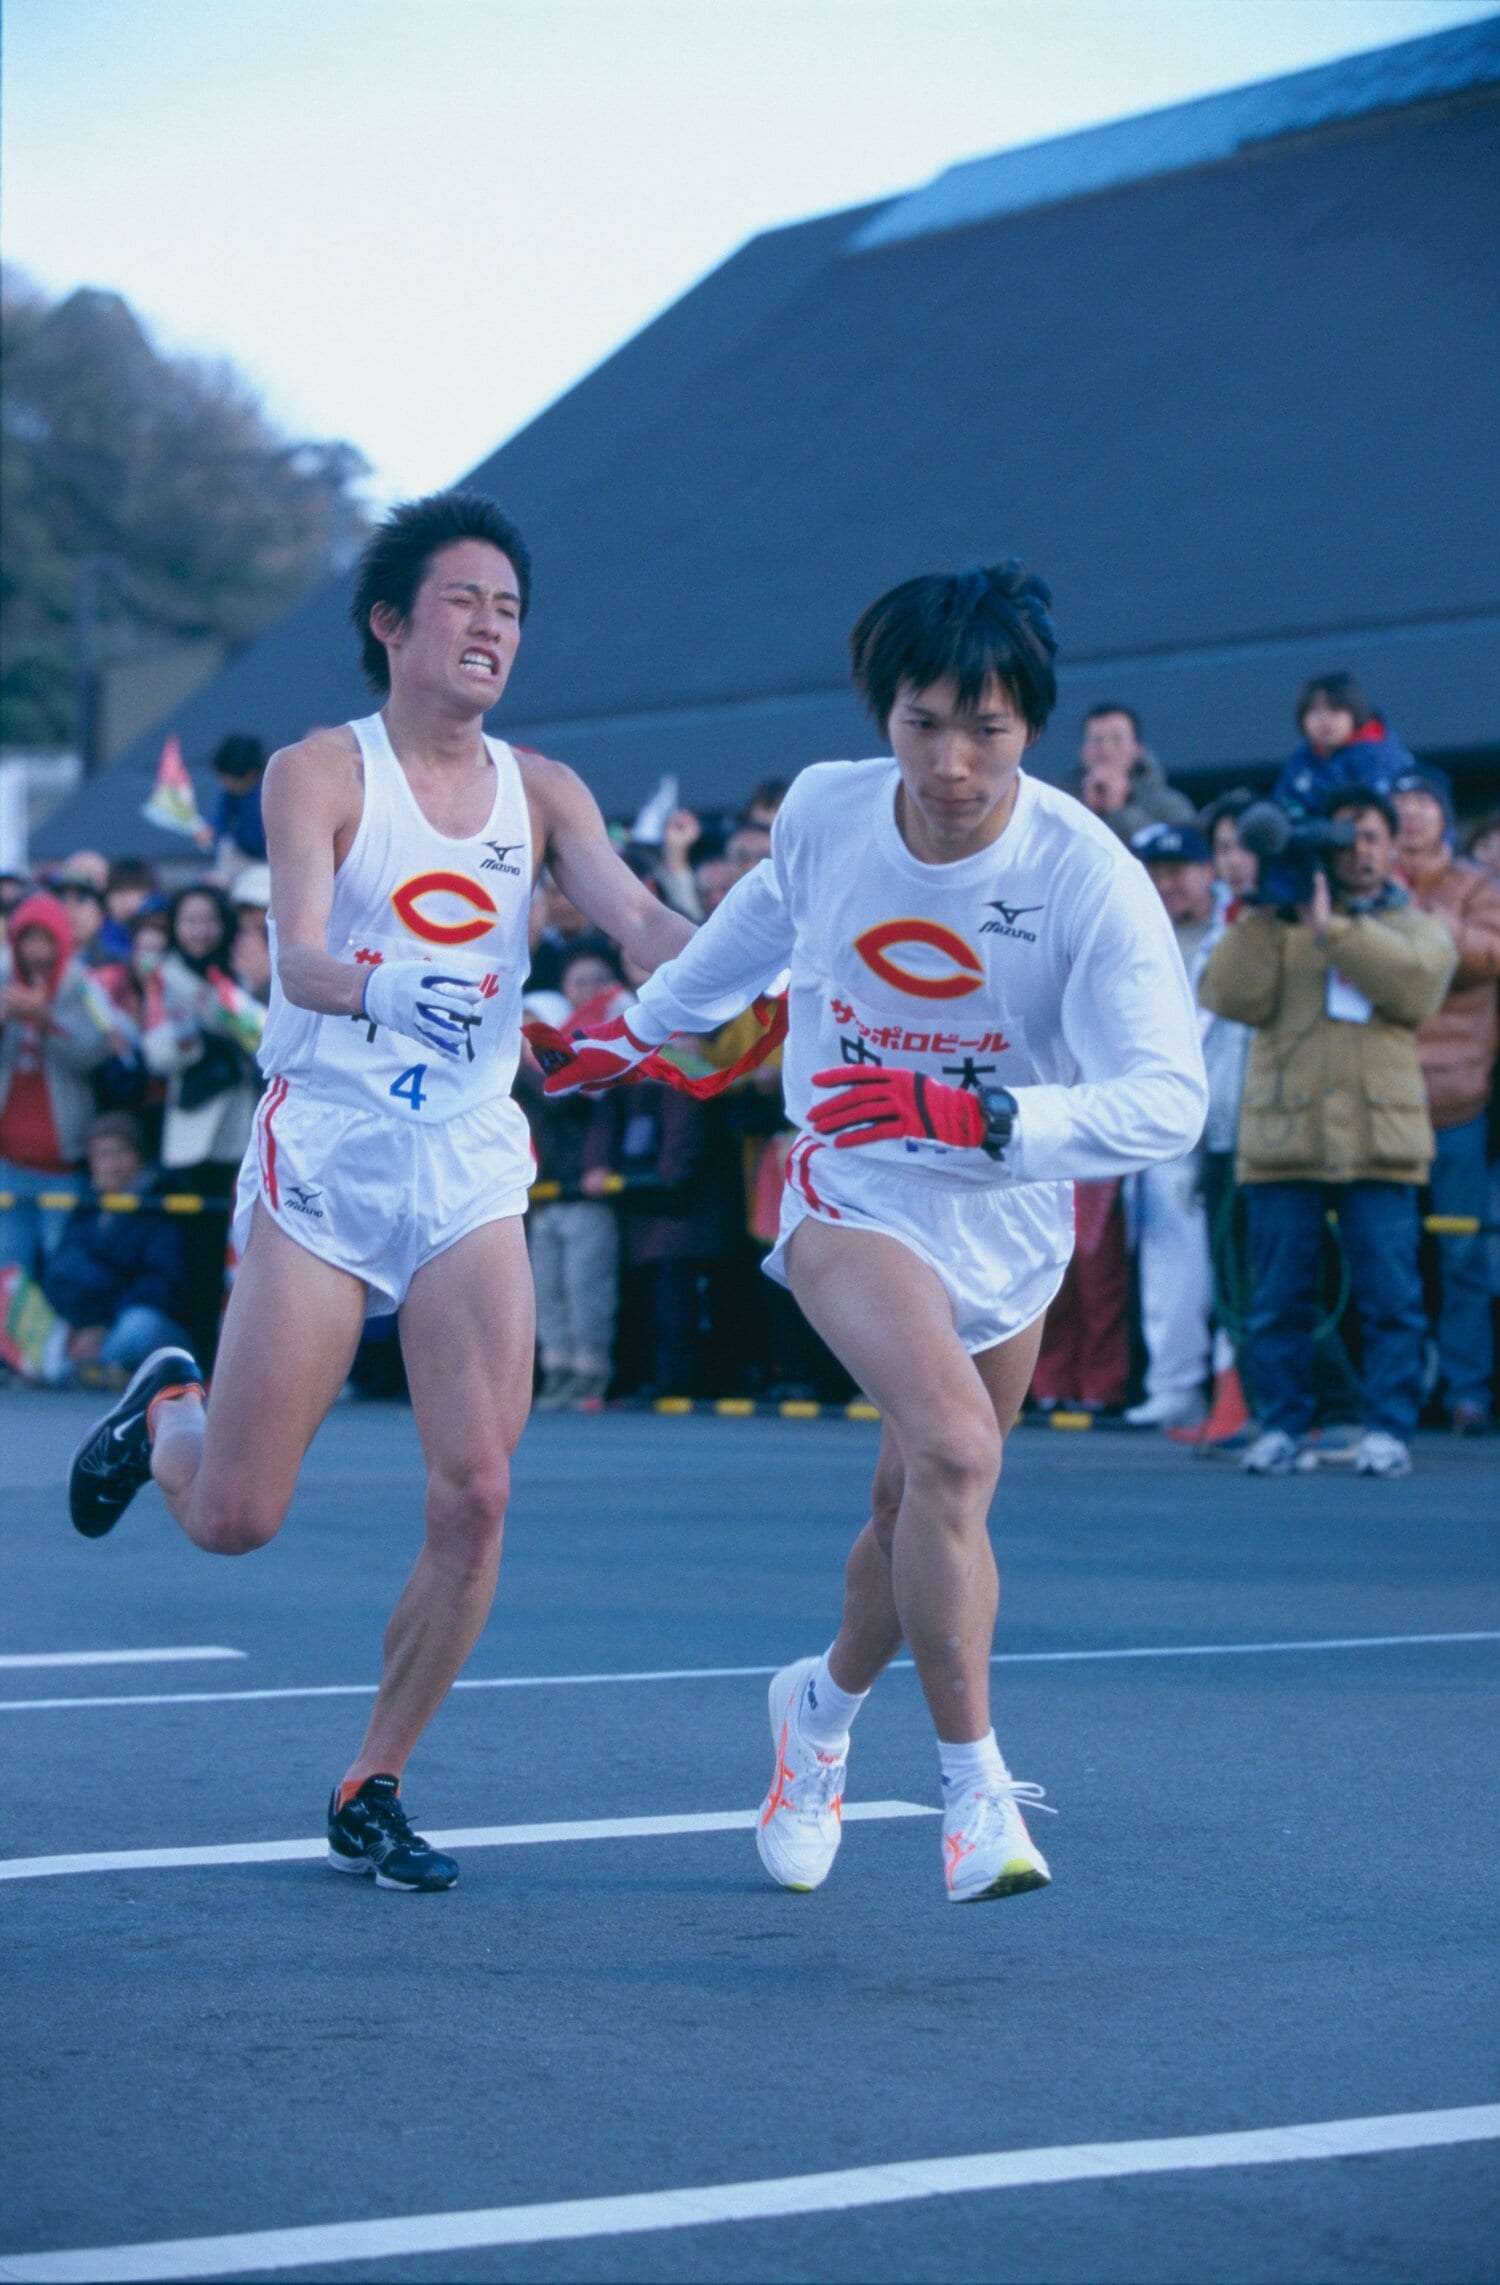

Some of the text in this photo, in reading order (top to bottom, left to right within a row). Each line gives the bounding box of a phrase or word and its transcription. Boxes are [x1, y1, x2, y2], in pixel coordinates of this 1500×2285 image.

[390, 870, 499, 946] C
[853, 916, 986, 1000] C
[830, 998, 1010, 1054] サッポロビール
[389, 1063, 427, 1111] 4
